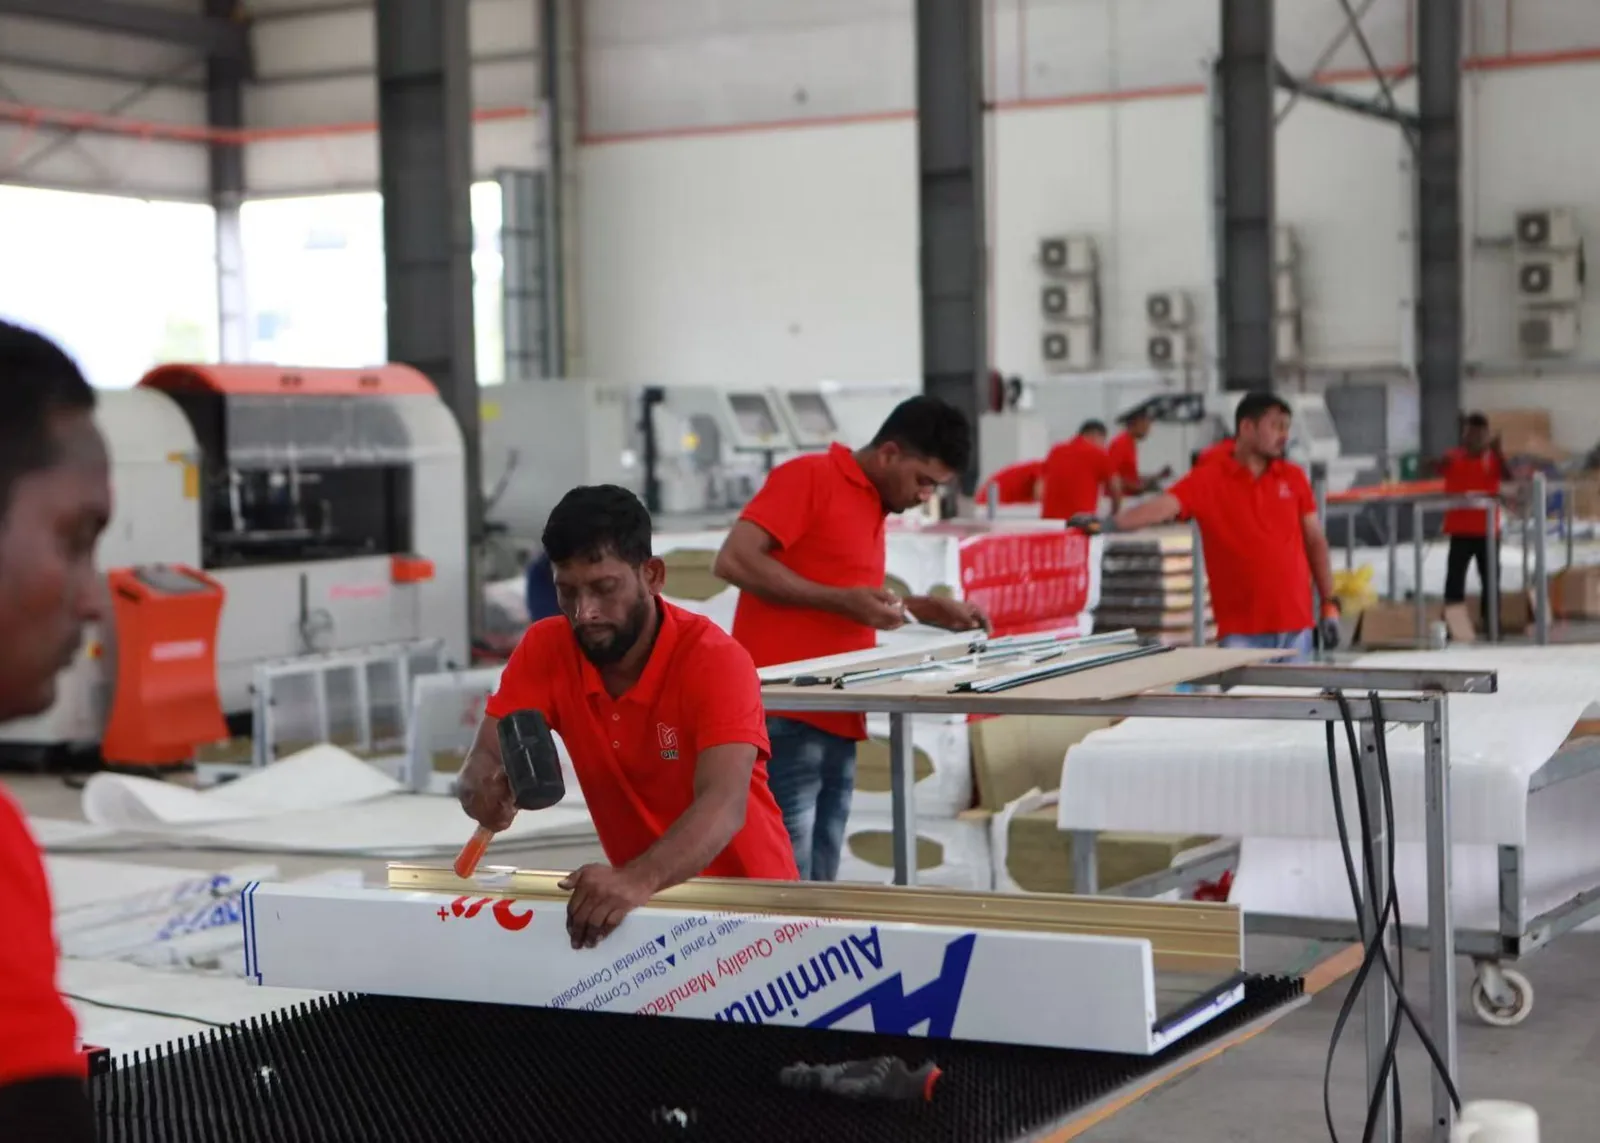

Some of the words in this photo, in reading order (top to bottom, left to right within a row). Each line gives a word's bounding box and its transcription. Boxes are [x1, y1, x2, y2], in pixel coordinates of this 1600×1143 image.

[612, 940, 657, 976] Bimetal
[680, 931, 717, 960] Panel
[716, 937, 773, 978] Quality
[551, 967, 612, 1008] Composite
[632, 959, 667, 989] Steel
[713, 925, 884, 1025] Aluminiu
